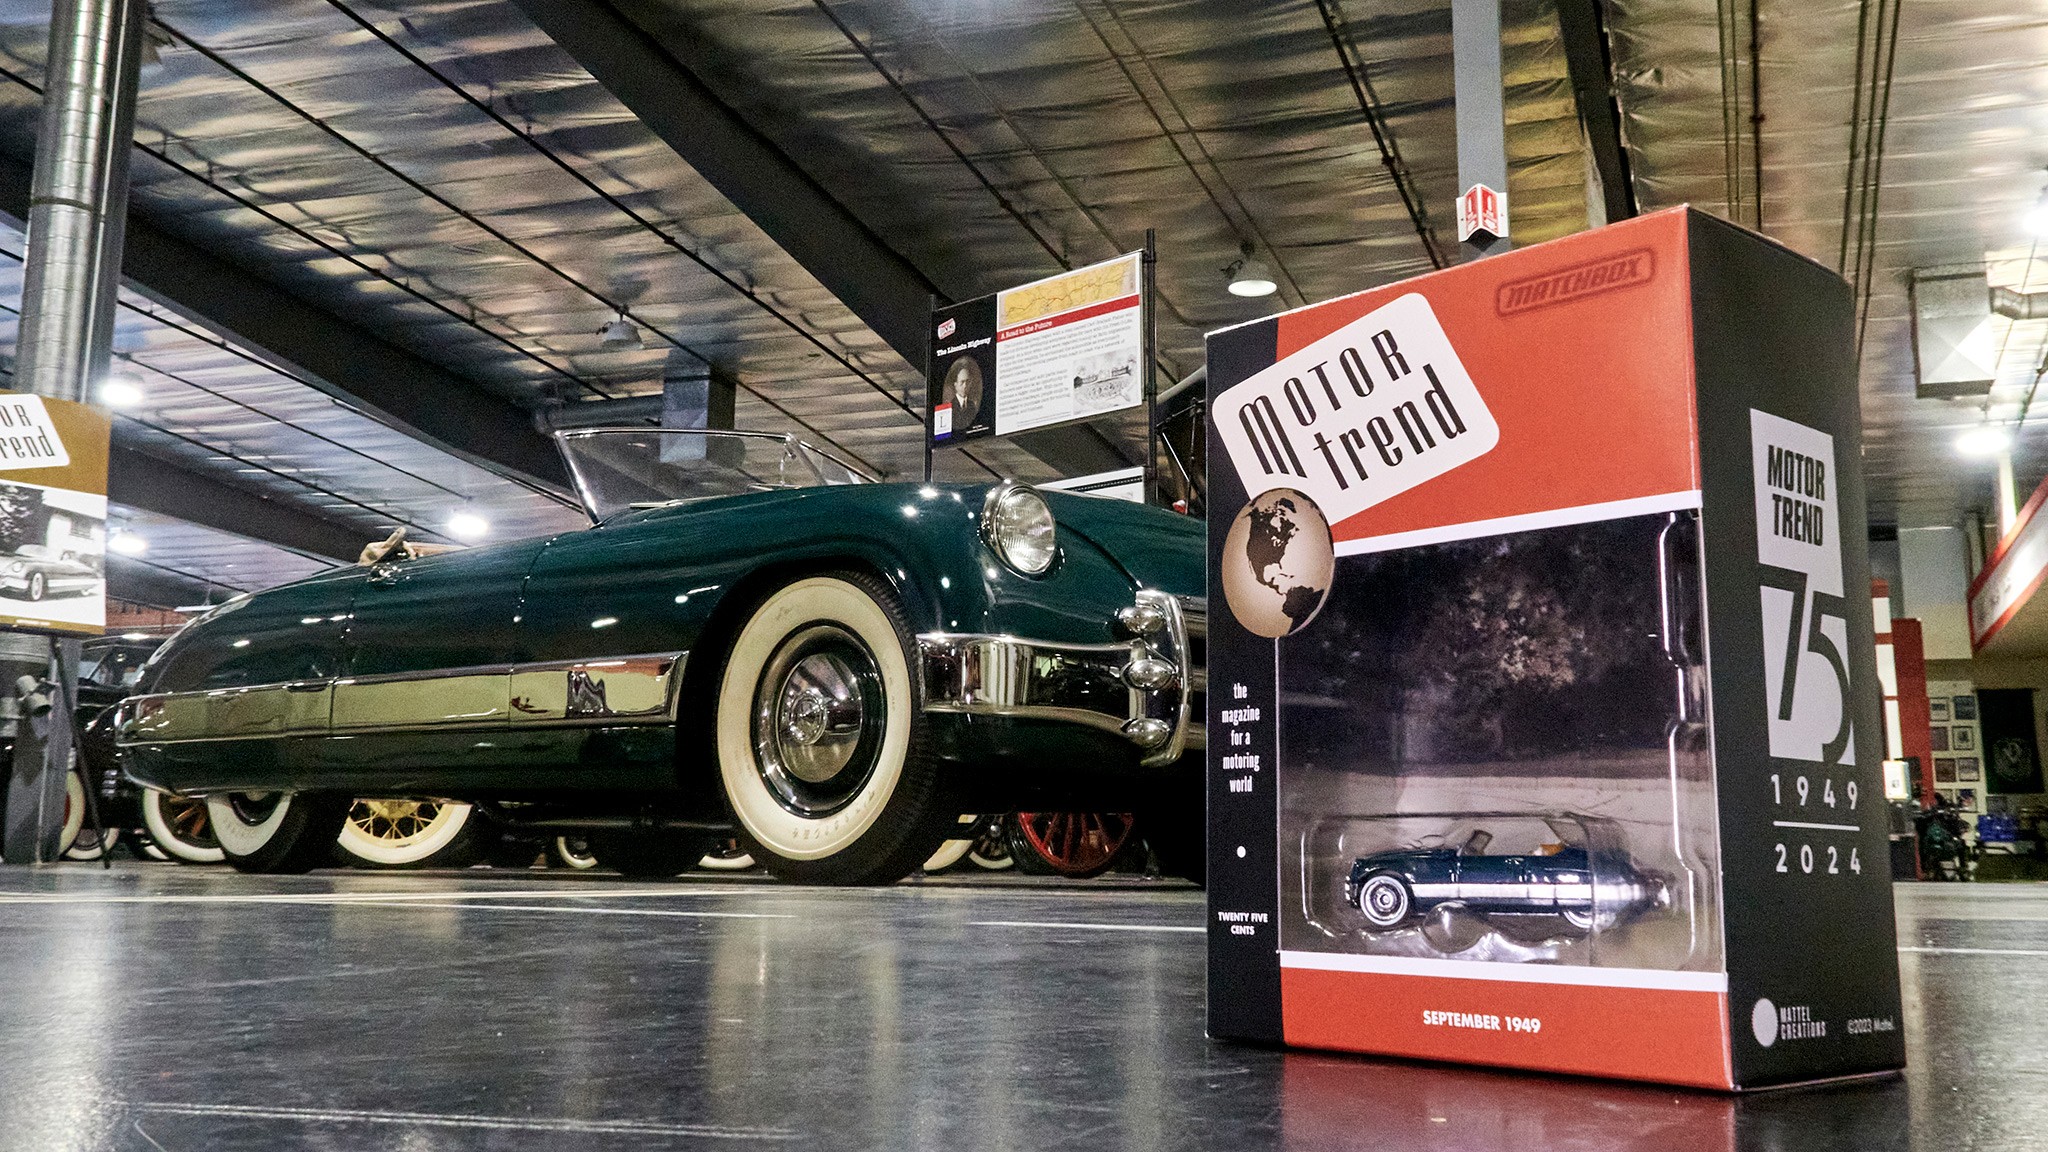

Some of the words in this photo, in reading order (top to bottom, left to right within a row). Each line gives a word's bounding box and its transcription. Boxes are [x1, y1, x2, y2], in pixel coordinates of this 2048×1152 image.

[1506, 256, 1642, 309] MATCHBOX
[1238, 329, 1412, 479] MOTOR
[1313, 363, 1468, 491] trend
[1767, 444, 1826, 502] MOTOR
[1772, 493, 1824, 547] TREND
[1759, 562, 1852, 764] 75
[1233, 682, 1248, 699] the
[1221, 704, 1260, 726] magazine
[1230, 729, 1243, 746] for
[1245, 731, 1251, 745] a
[1222, 751, 1260, 772] motoring
[1229, 775, 1253, 793] world
[1217, 911, 1250, 922] TWENTY
[1250, 912, 1268, 923] FIVE
[1230, 924, 1255, 936] CENTS
[1423, 1010, 1501, 1030] SEPTEMBER
[1504, 1016, 1541, 1033] 1949
[1780, 1006, 1811, 1023] MATTEL
[1780, 1021, 1826, 1040] CREATIONS
